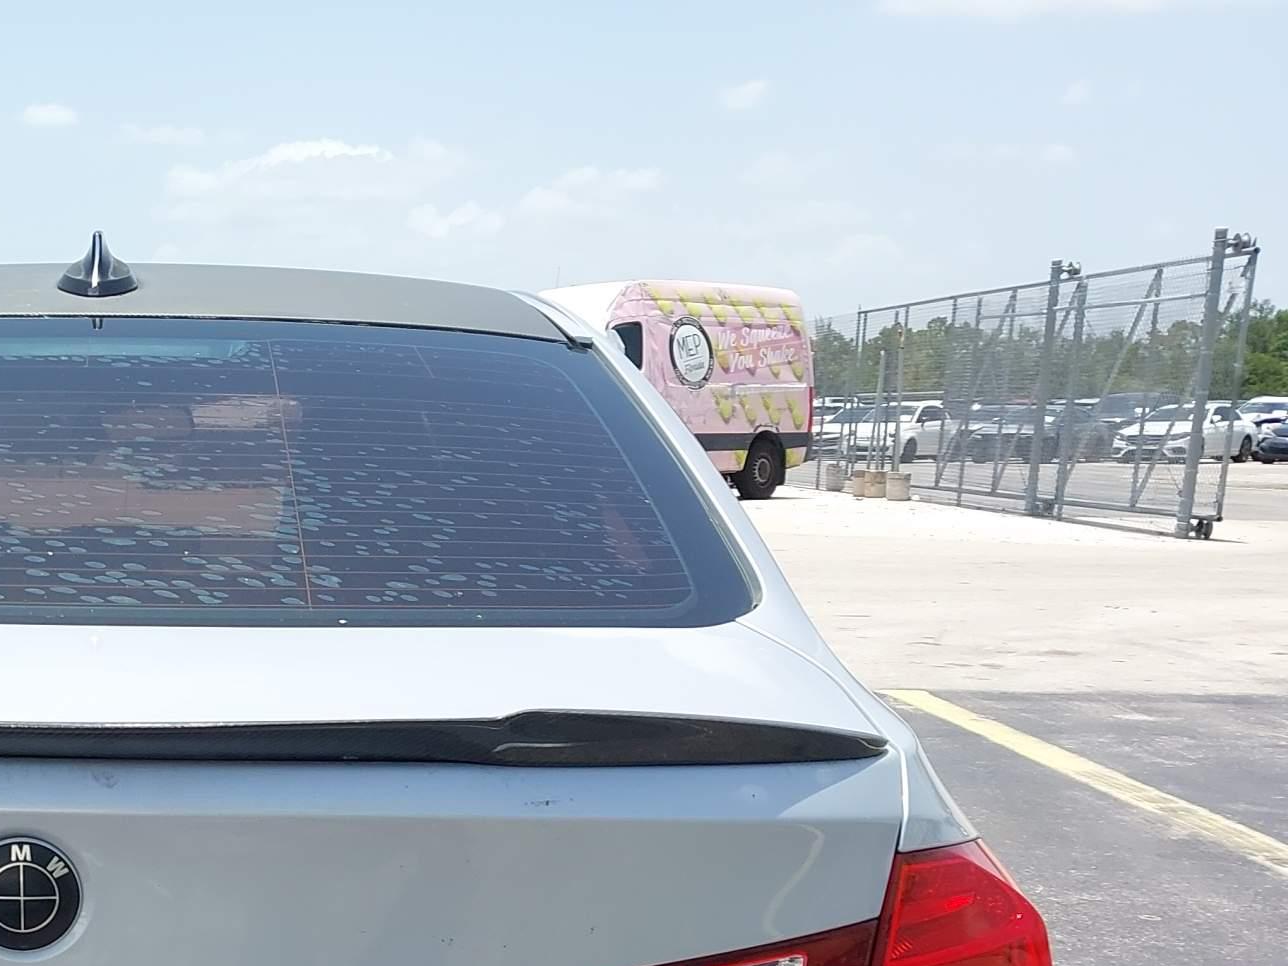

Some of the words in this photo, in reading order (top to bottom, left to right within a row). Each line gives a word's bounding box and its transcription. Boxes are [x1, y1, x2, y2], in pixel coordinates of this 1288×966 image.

[677, 333, 702, 360] MEP
[717, 330, 737, 349] We
[730, 352, 754, 373] You
